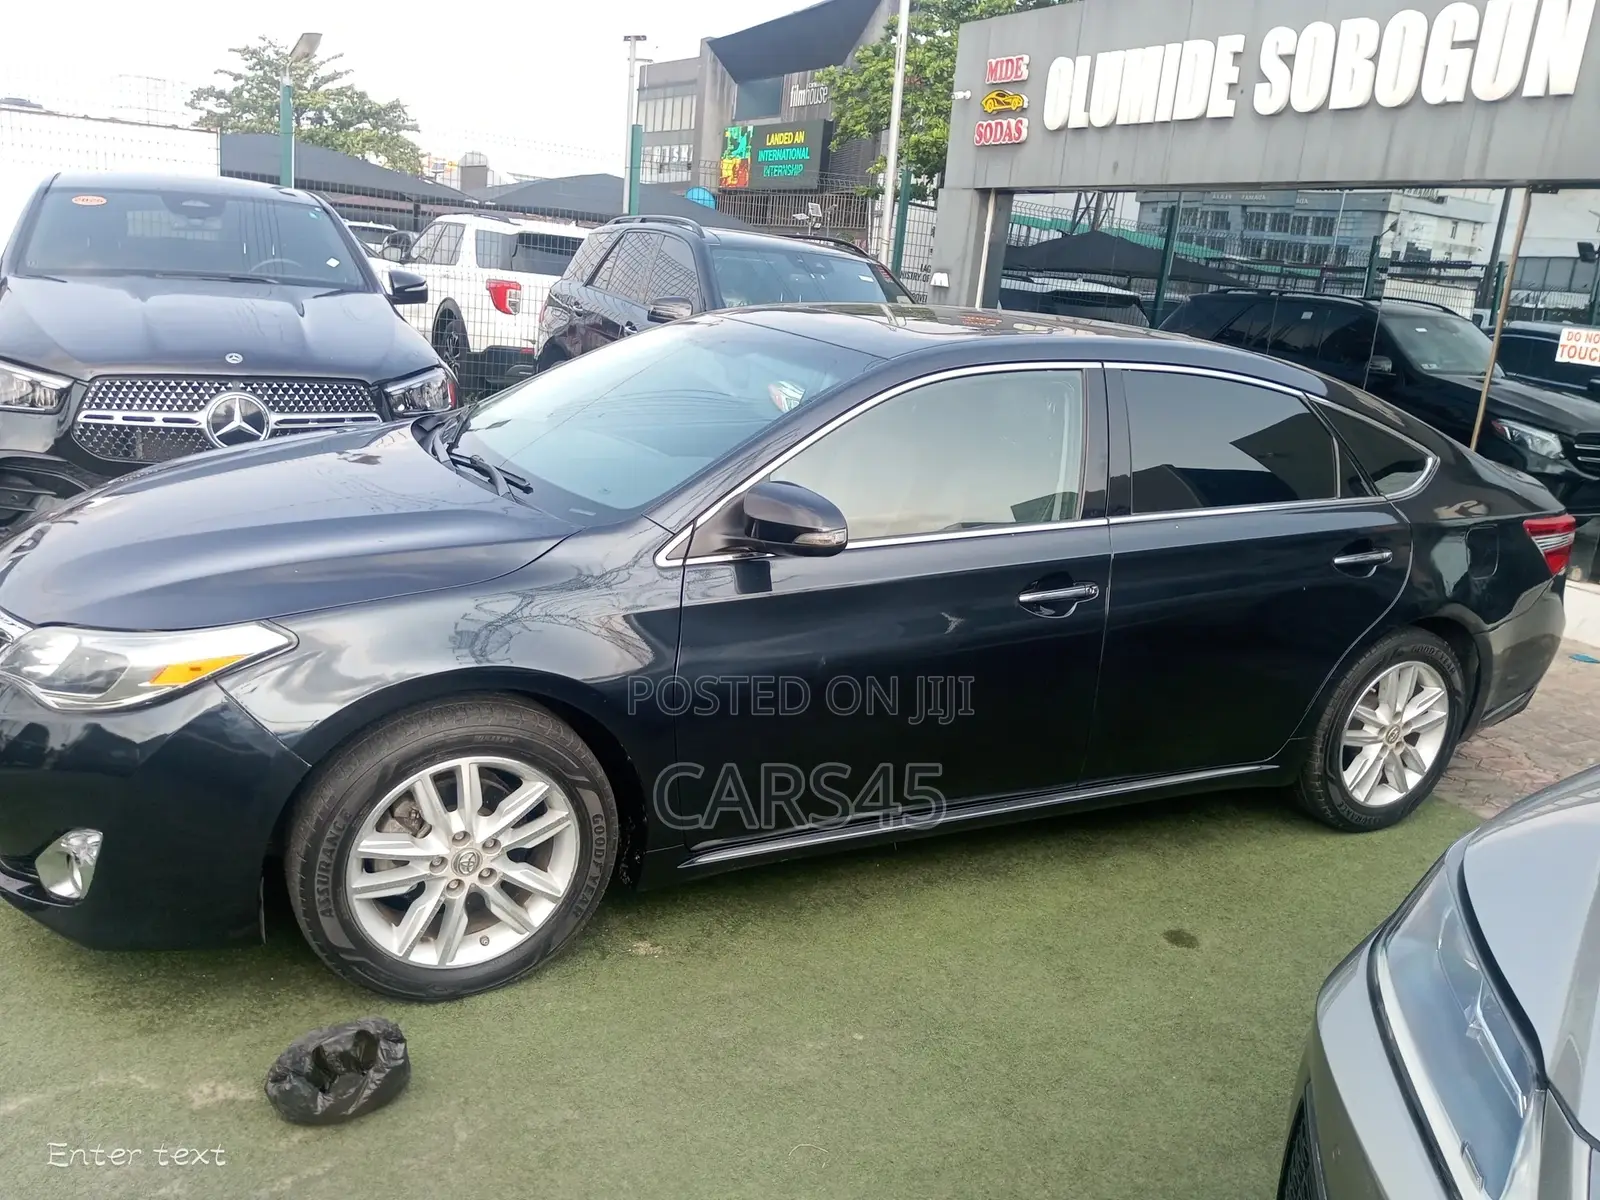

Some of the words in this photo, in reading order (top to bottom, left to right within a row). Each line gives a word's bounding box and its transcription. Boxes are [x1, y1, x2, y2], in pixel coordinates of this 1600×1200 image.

[986, 55, 1028, 83] MIDE
[1043, 34, 1245, 131] OLUMIDE
[1253, 0, 1597, 116] SOBOGUN
[790, 84, 829, 108] filmhouse
[766, 132, 794, 146] LANDED
[794, 131, 805, 144] AN
[974, 118, 1028, 145] SODAS
[758, 147, 810, 162] INTERNATIONAL
[763, 164, 804, 177] INTERNSHIP
[1567, 331, 1581, 342] DO
[1560, 344, 1600, 362] TOUC
[315, 808, 352, 918] ASSURANCE
